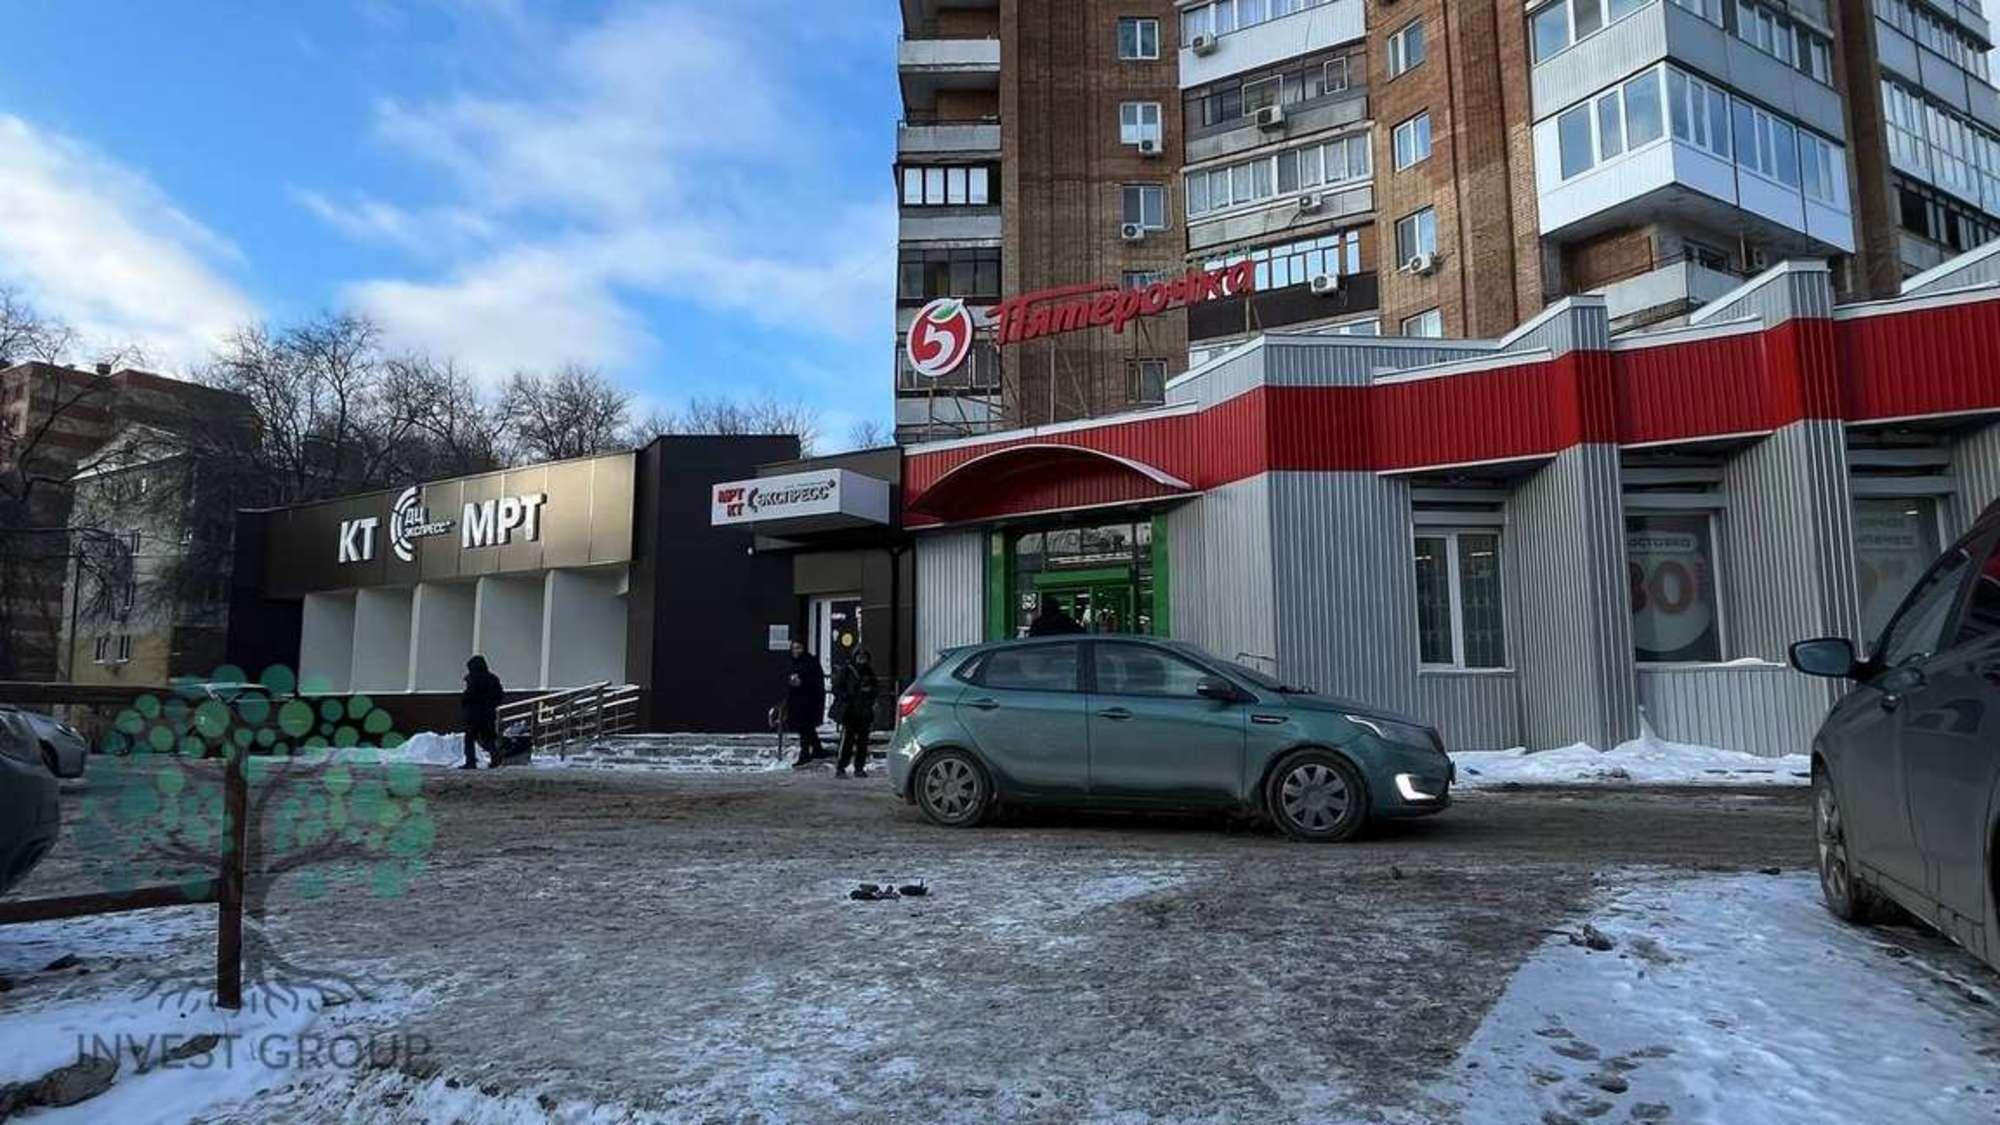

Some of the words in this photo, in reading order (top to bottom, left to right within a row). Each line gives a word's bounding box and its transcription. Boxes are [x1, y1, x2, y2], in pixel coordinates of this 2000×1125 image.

[918, 323, 957, 366] 5
[718, 487, 745, 503] МРТ
[757, 485, 830, 507] ЭКСПРЕСС
[404, 507, 425, 526] ДЦ
[727, 503, 745, 517] КТ
[404, 522, 446, 538] ЭКСПРЕСС
[462, 493, 544, 548] МРТ
[338, 517, 380, 563] КТ
